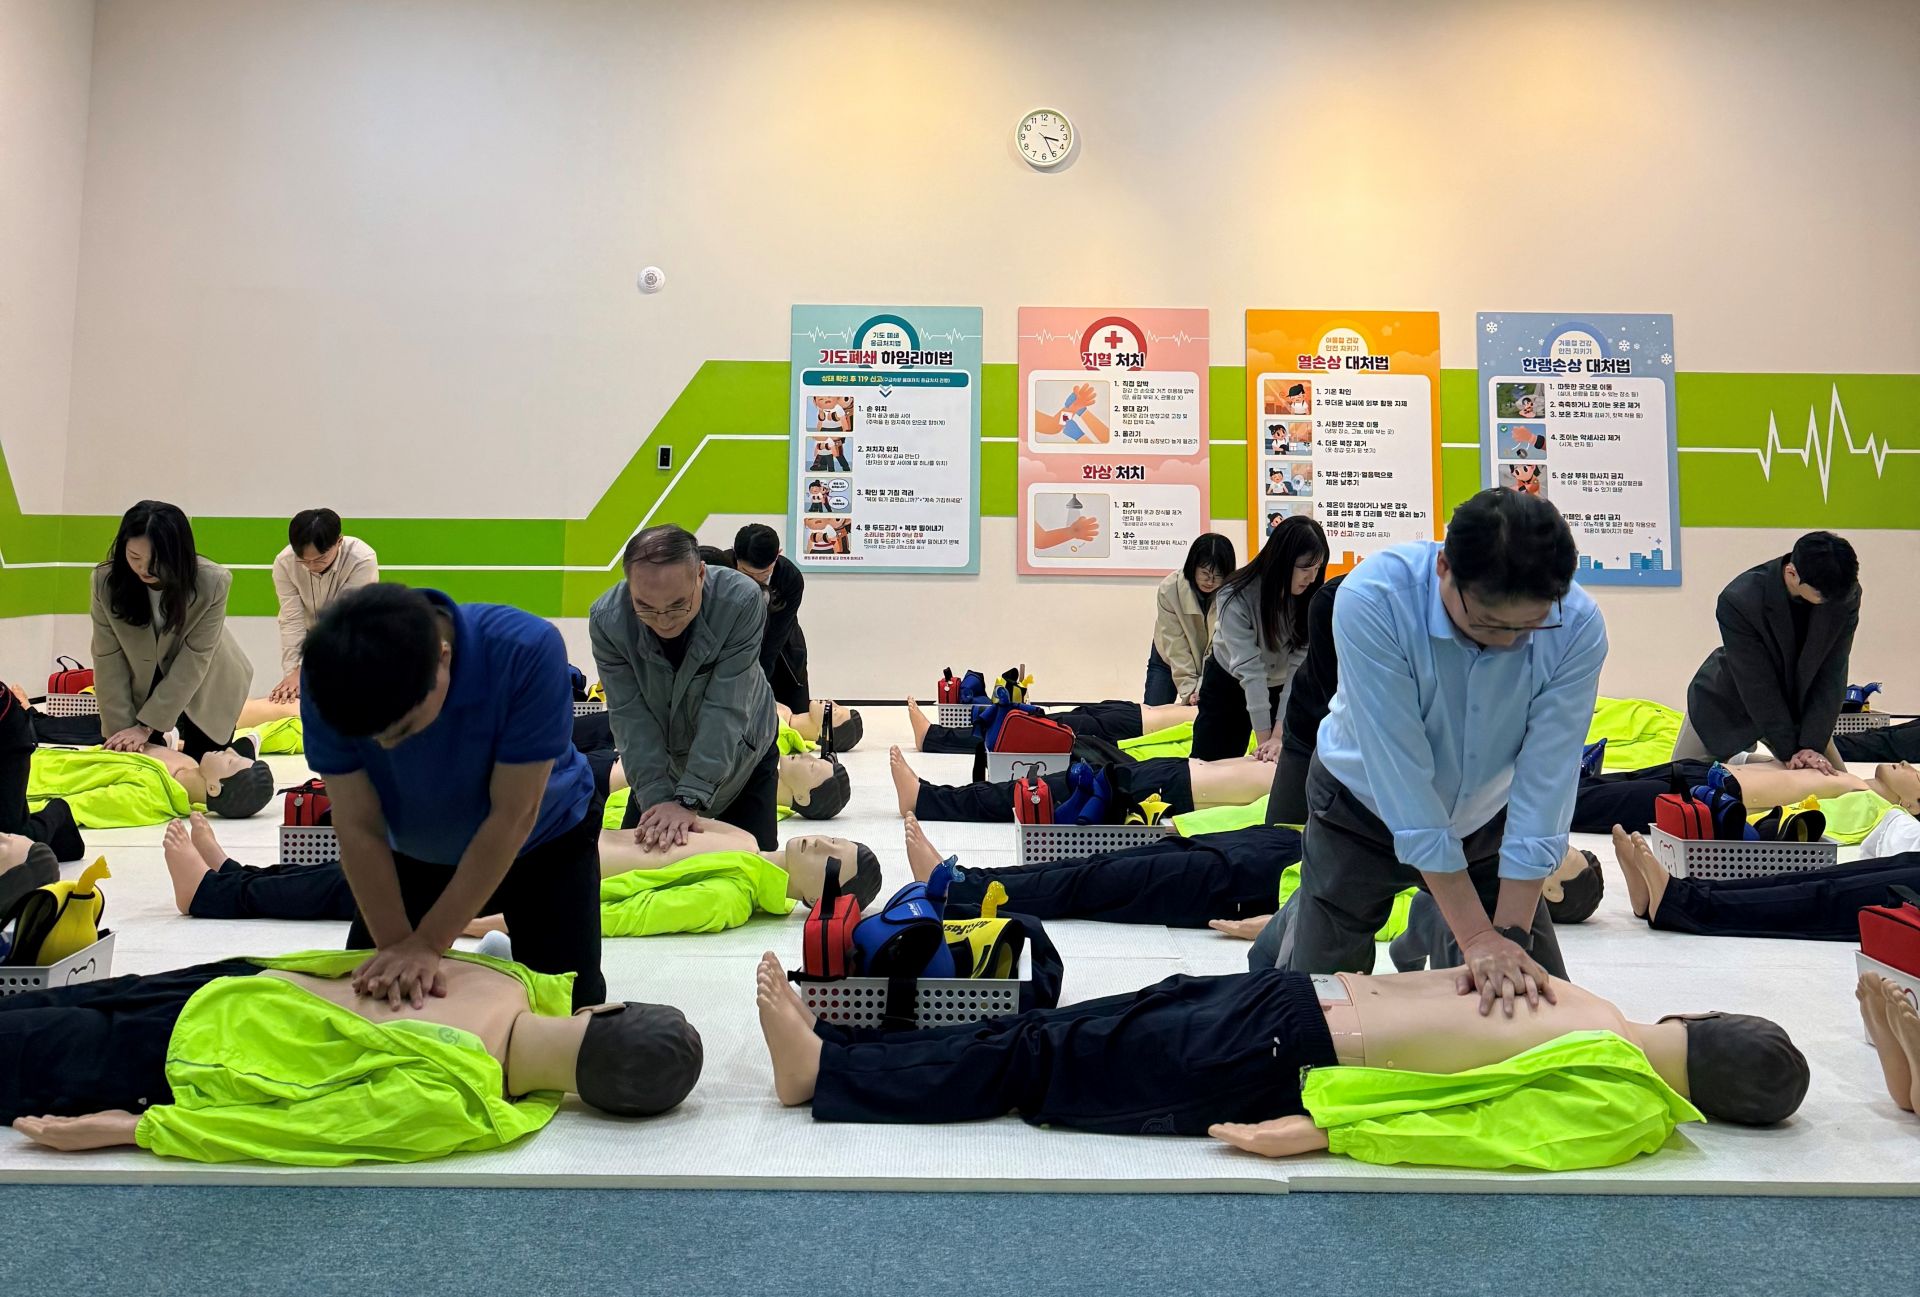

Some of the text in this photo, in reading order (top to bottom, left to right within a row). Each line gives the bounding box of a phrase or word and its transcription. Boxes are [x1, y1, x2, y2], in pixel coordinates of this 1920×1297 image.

[820, 350, 953, 365] 기도폐쇄 하임리히법
[1083, 353, 1143, 366] 지혈 처치
[1298, 355, 1388, 370] 열손상 대처법
[1522, 358, 1630, 373] 한랭손상 대처법
[1083, 465, 1144, 479] 화상 처치
